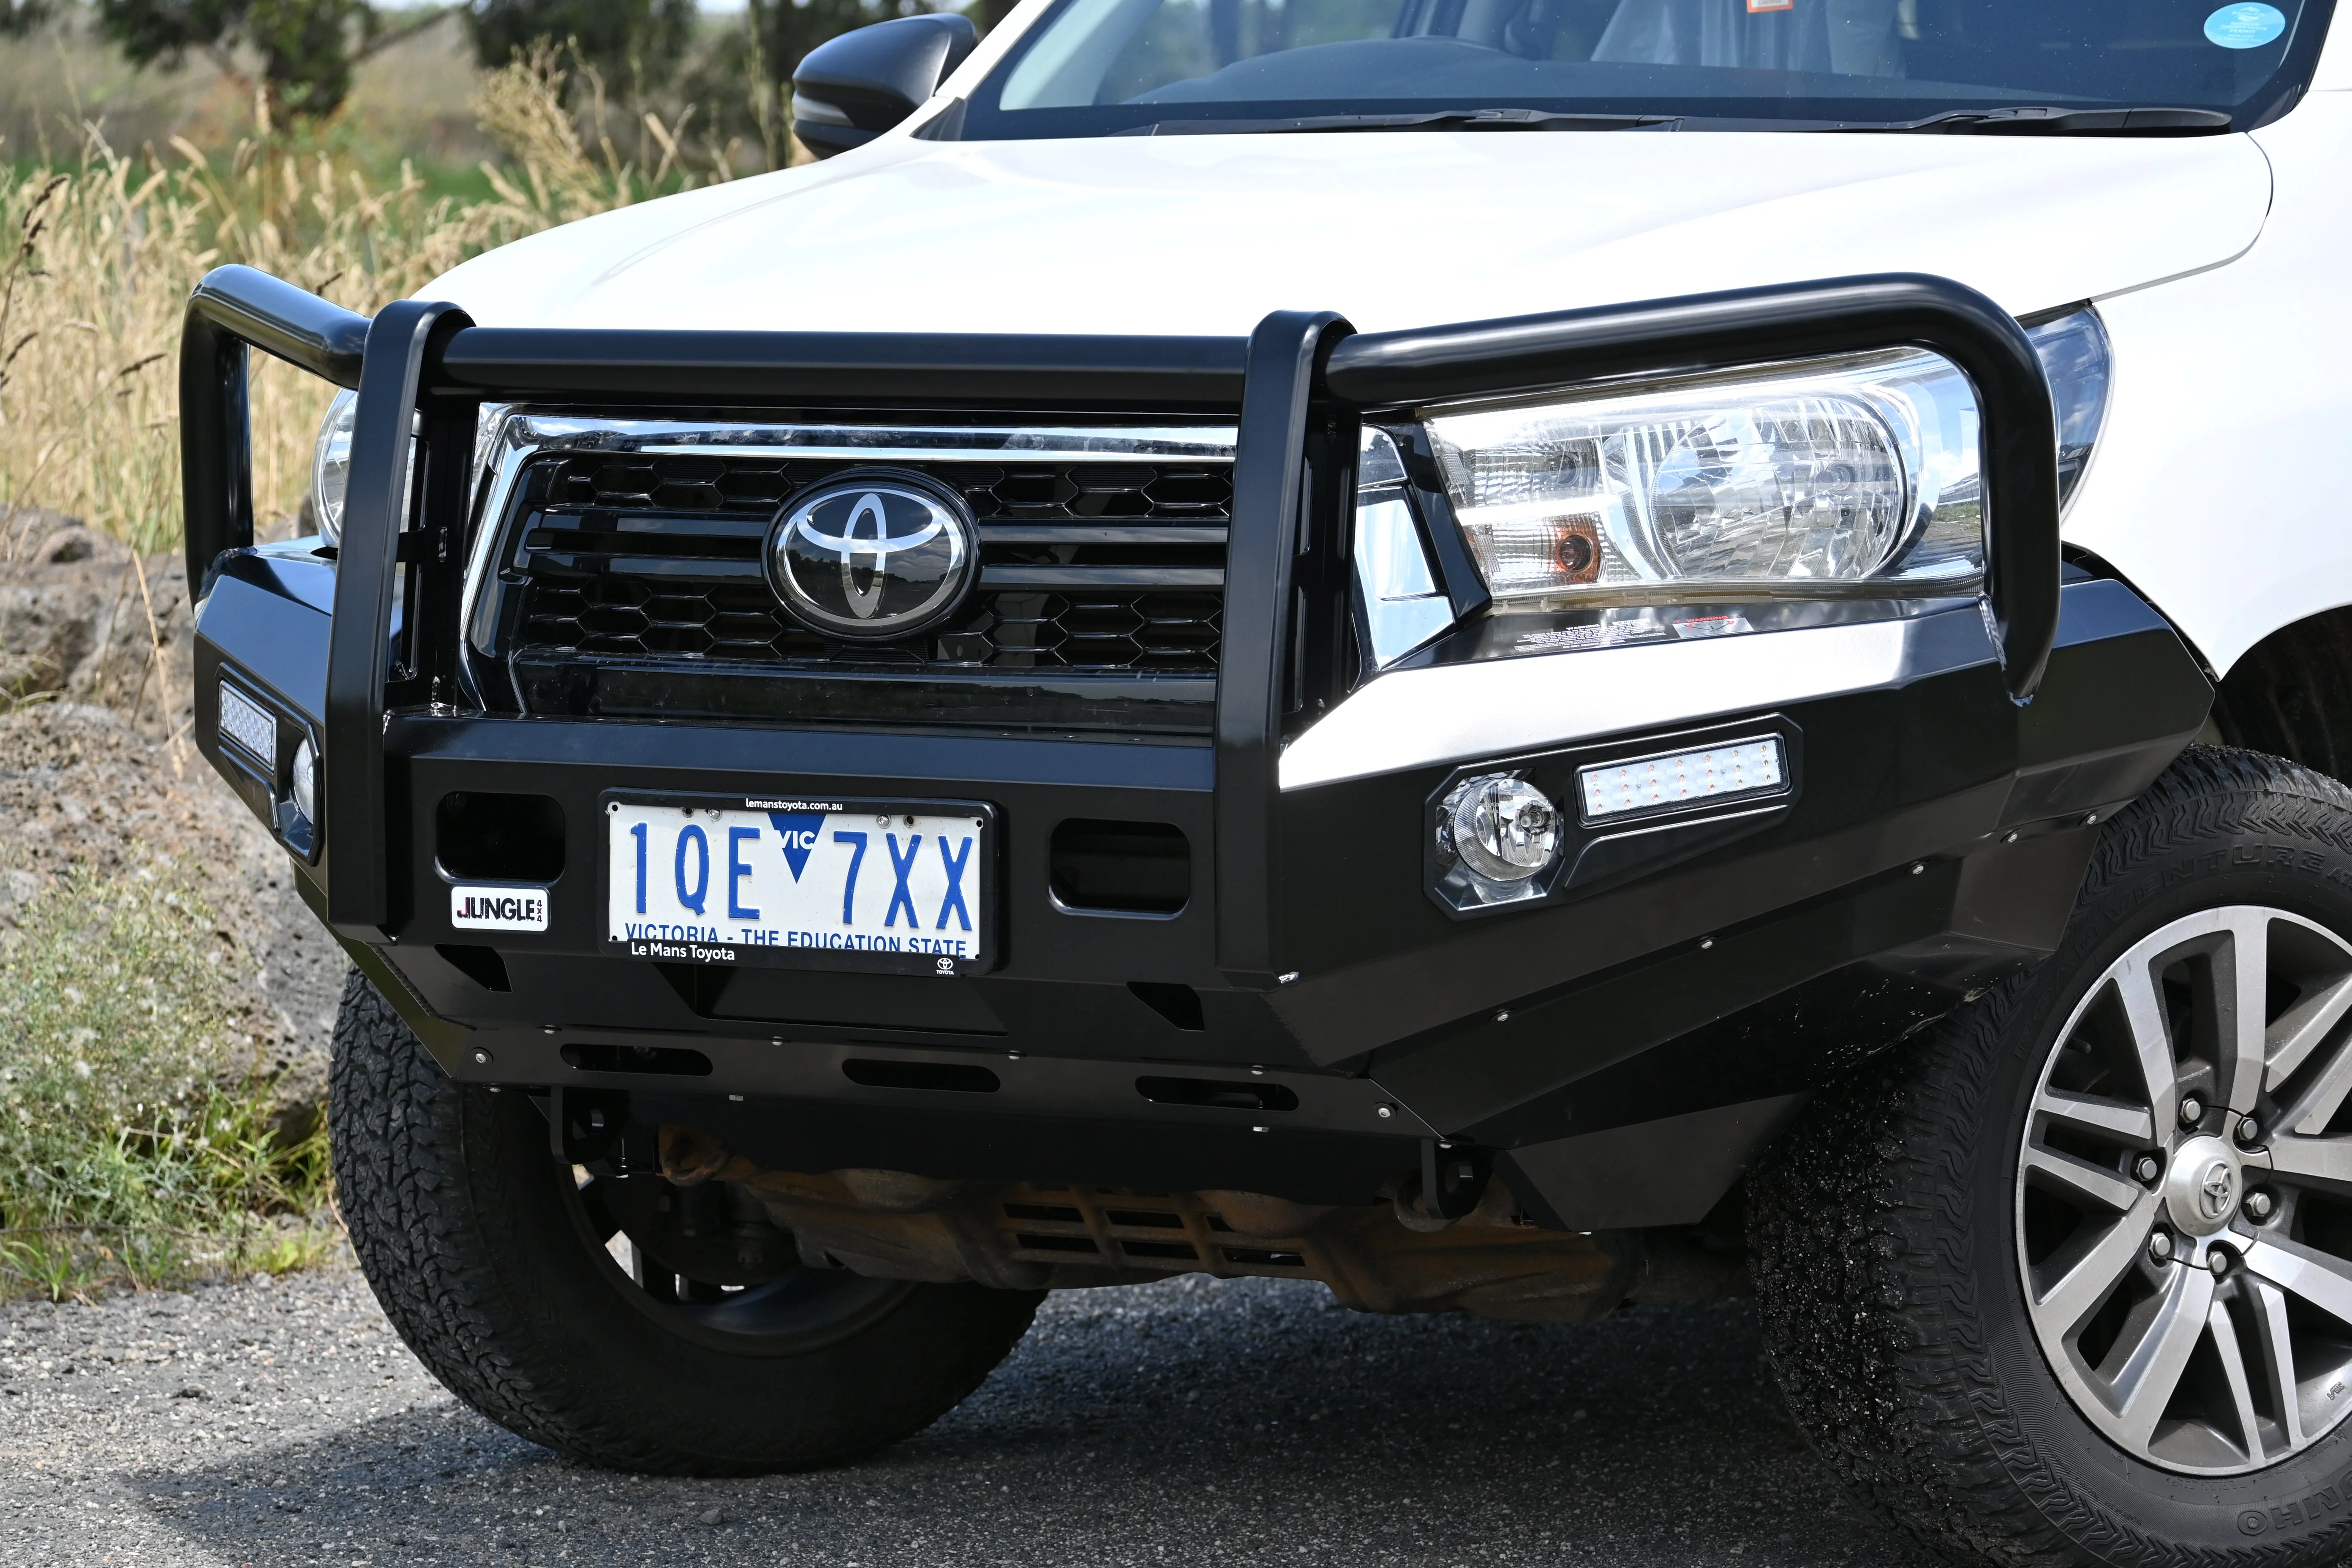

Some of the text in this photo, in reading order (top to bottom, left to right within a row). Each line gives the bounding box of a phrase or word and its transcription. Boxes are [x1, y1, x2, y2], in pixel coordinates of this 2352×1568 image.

[746, 798, 842, 811] lemanstoyota.com.au
[774, 830, 815, 849] VIC
[630, 822, 973, 931] 1QE 7XX
[2104, 844, 2325, 923] VENTURE
[2327, 867, 2352, 890] AT
[457, 897, 535, 921] JUNGLE
[625, 923, 718, 942] VICTORIA
[741, 929, 779, 946] THE
[788, 931, 900, 952] EDUCATION
[909, 937, 966, 958] STATE
[632, 942, 735, 962] Le Mans Toyota
